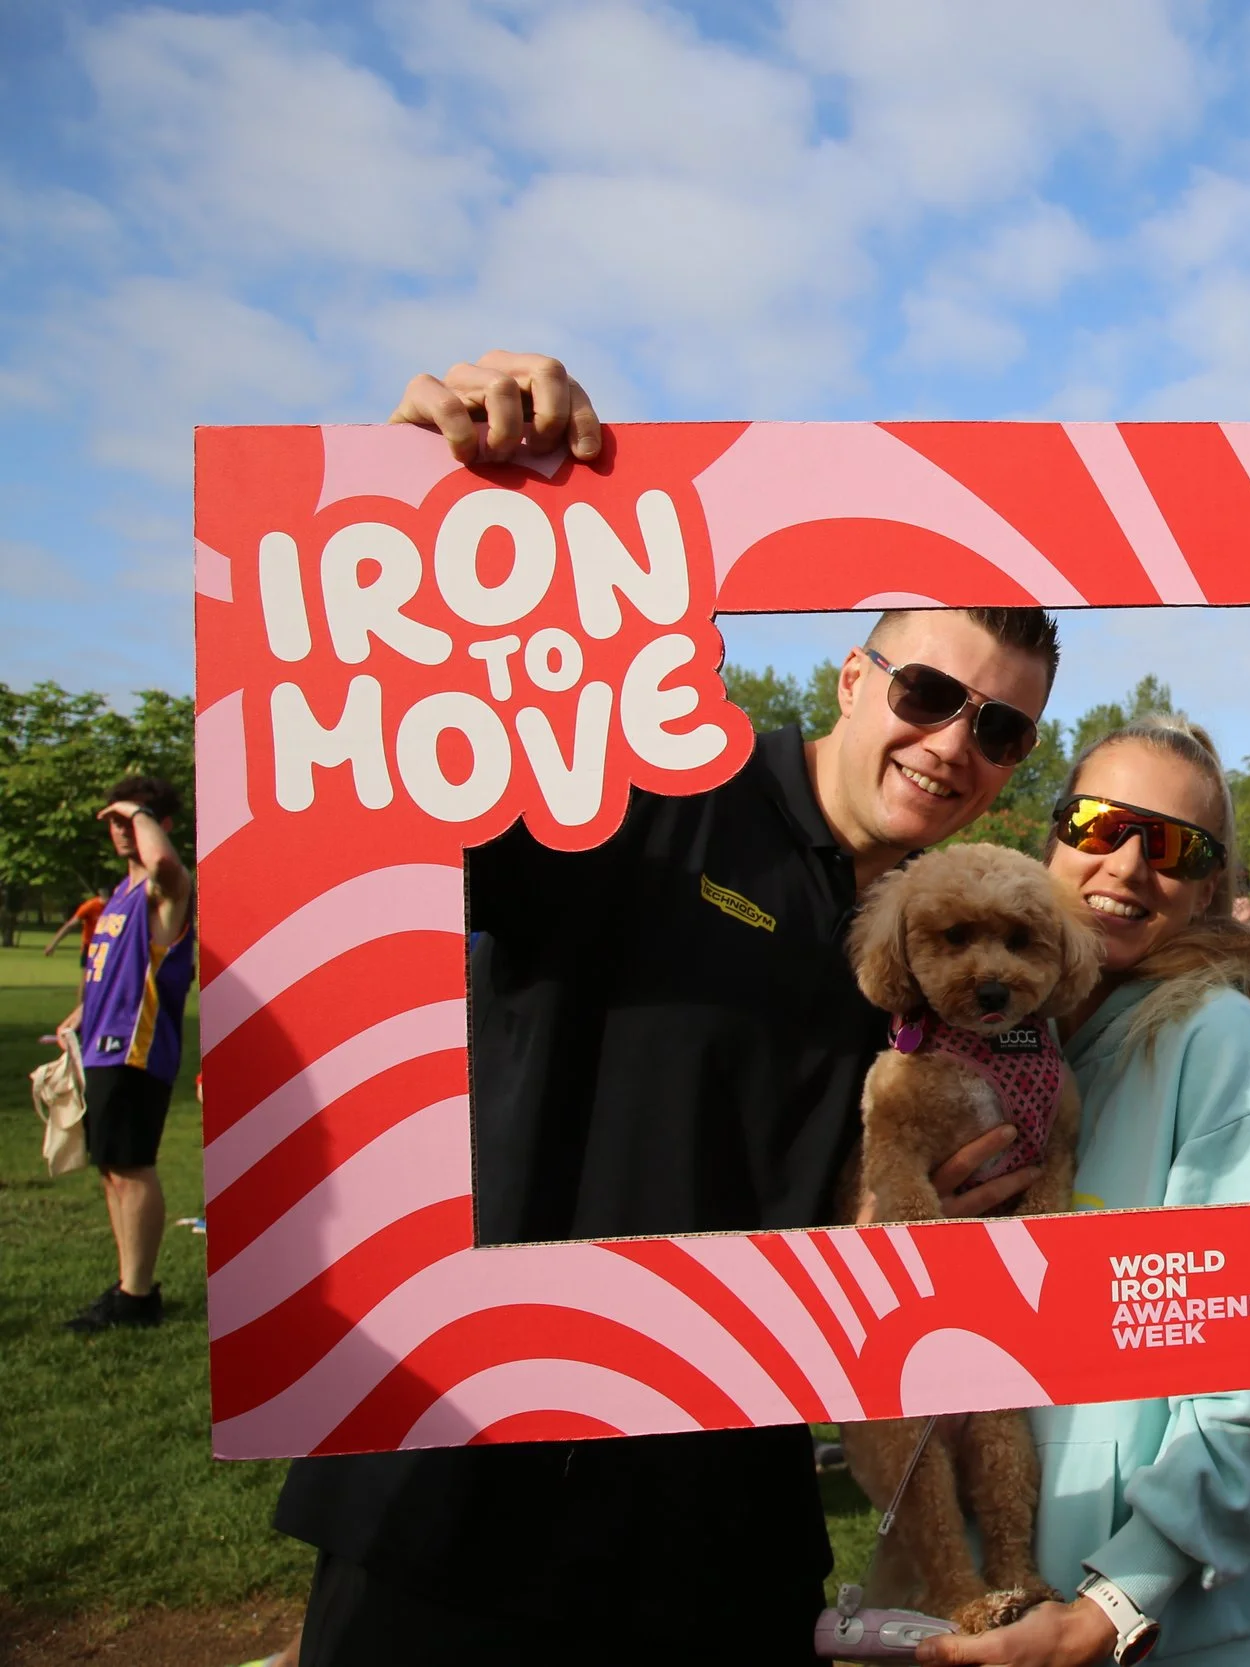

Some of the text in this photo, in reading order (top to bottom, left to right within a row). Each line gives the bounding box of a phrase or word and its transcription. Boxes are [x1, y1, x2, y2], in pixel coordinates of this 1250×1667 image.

[259, 488, 690, 666] IRON
[468, 627, 584, 701] TO
[270, 633, 728, 826] MOVE
[1109, 1250, 1226, 1278] WORLD
[1111, 1276, 1187, 1302] IRON
[1112, 1322, 1206, 1350] WEEK
